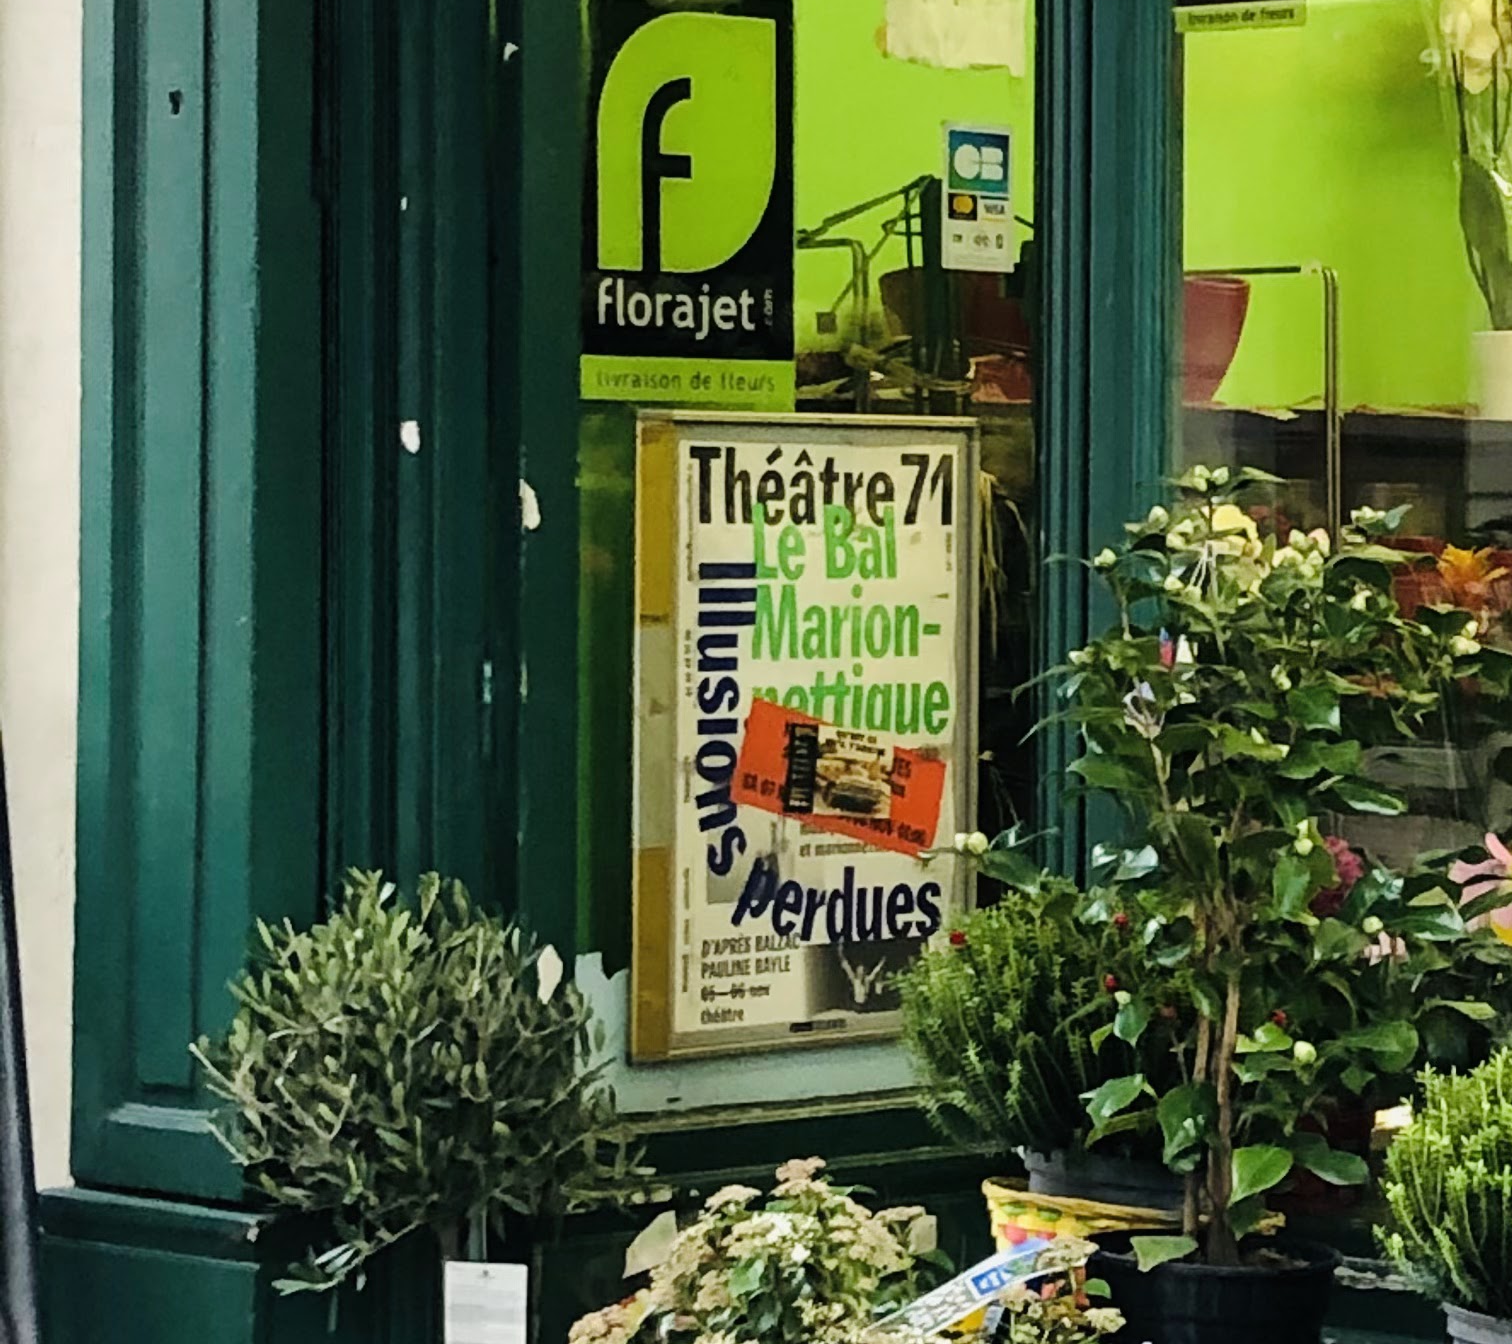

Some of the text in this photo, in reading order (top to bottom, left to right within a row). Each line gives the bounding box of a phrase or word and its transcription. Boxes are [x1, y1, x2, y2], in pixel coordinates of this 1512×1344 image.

[597, 277, 756, 340] florajet
[596, 368, 682, 391] livraison
[689, 370, 712, 391] de
[689, 445, 895, 527] Théâtre
[900, 453, 953, 526] 71
[752, 503, 806, 580] Le
[823, 503, 897, 579] Bal
[752, 583, 942, 662] Marion-
[694, 562, 757, 876] Illusions
[701, 958, 751, 979] PAULINE
